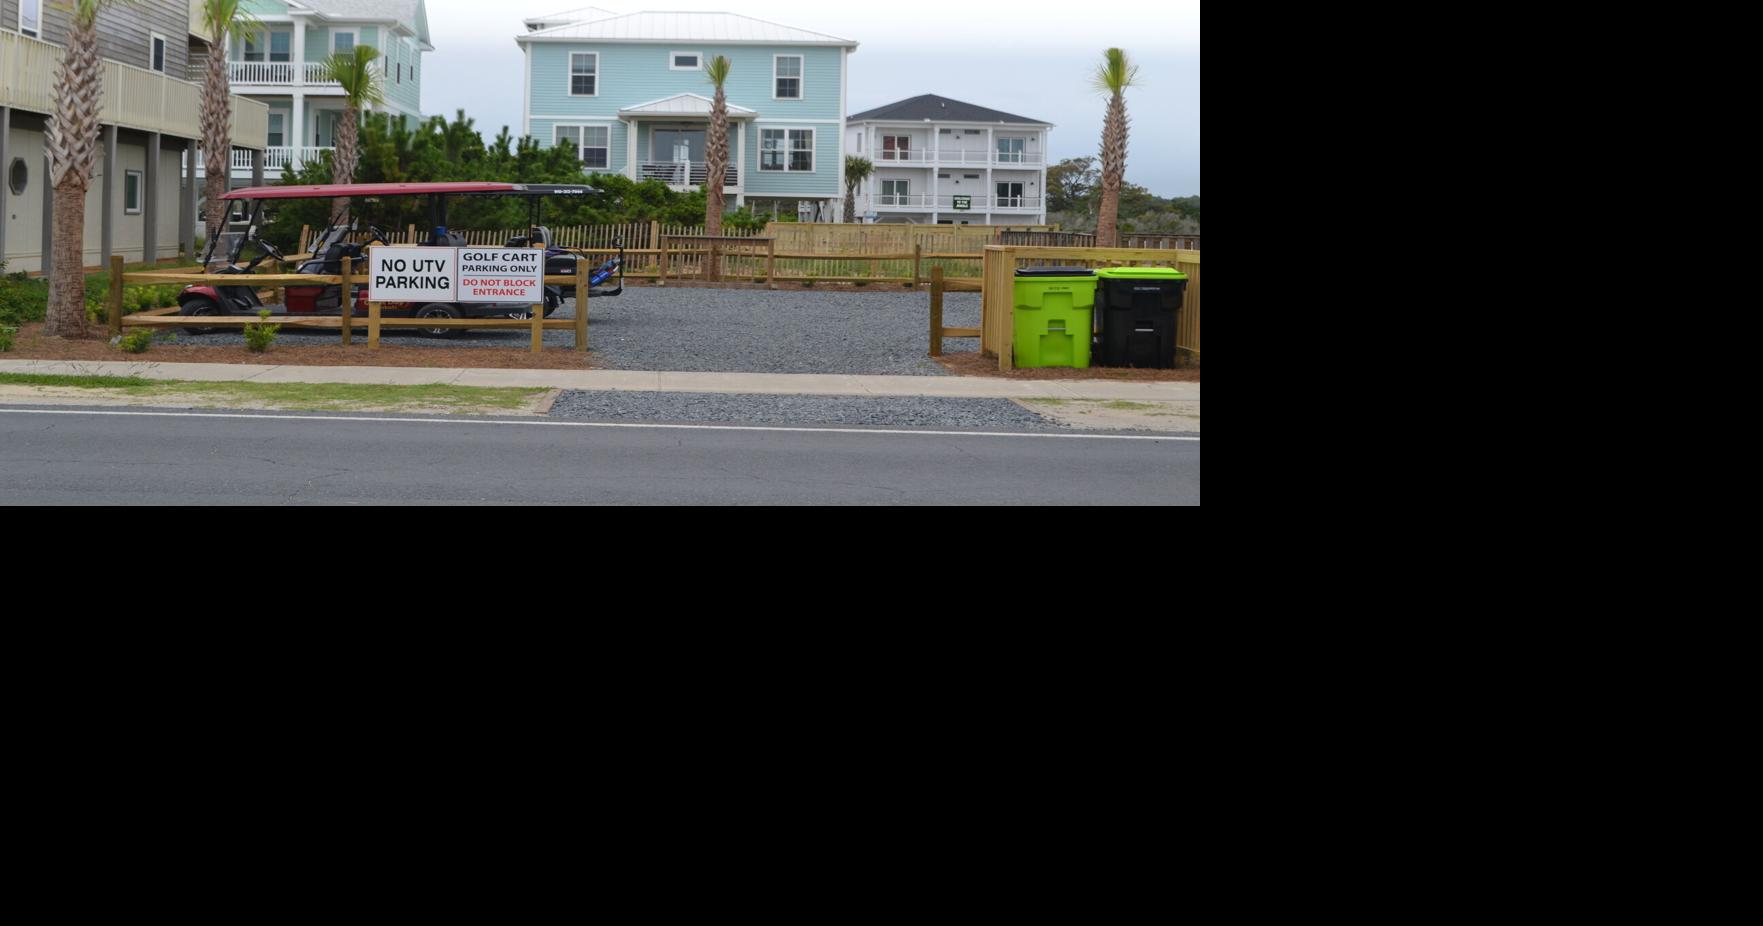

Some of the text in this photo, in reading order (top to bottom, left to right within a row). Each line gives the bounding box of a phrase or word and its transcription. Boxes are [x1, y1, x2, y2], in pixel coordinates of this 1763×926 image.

[463, 252, 537, 262] GOLF CART
[381, 259, 446, 273] NO UTV
[510, 265, 537, 273] ONLY
[375, 276, 450, 290] PARKING
[463, 279, 536, 287] DO NOT BLOCK
